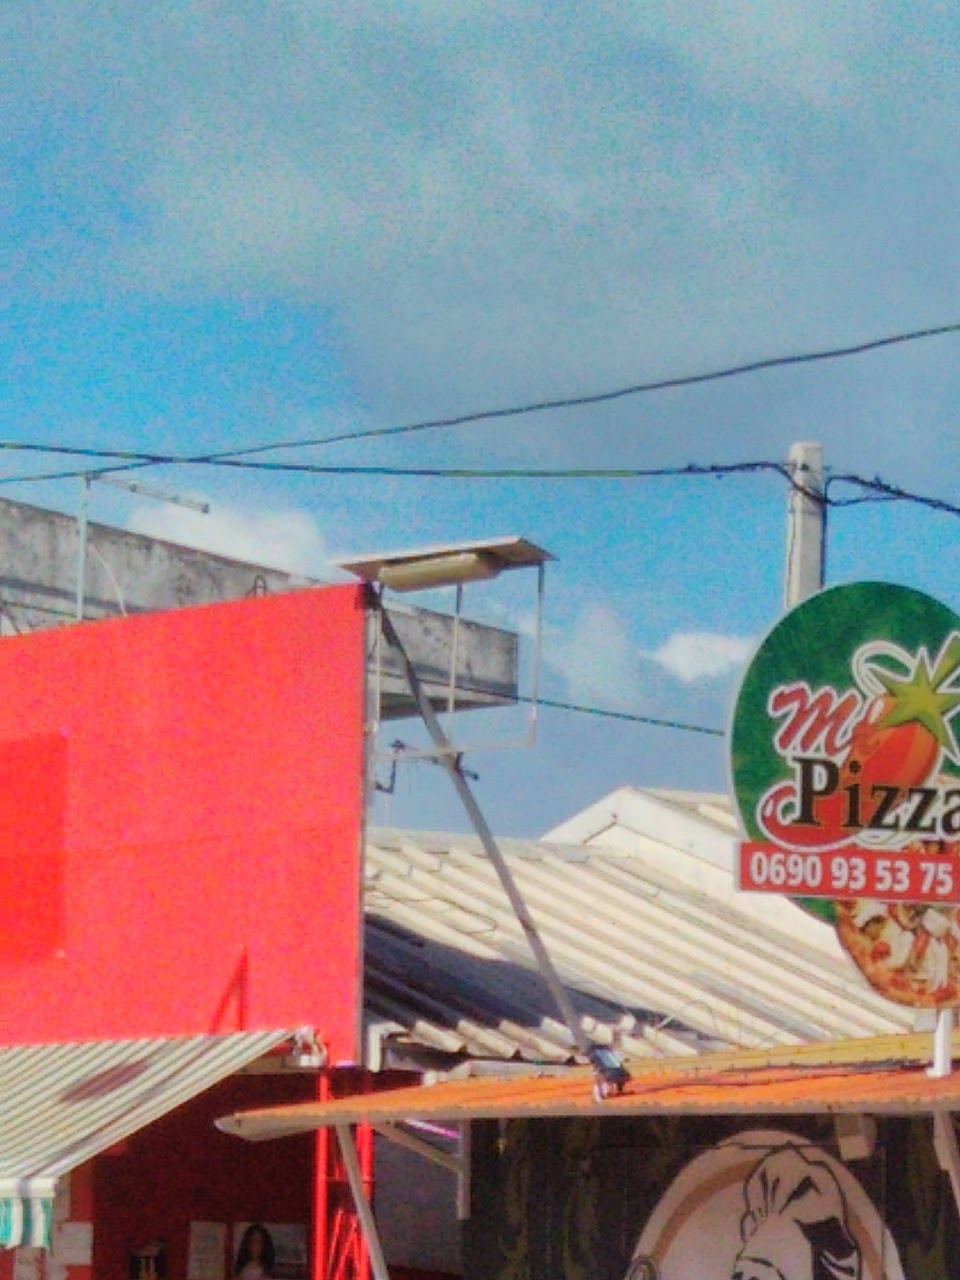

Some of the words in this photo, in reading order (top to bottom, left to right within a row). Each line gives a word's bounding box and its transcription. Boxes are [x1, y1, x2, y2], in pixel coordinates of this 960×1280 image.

[751, 851, 823, 887] 0690
[830, 856, 866, 890] 93
[874, 859, 910, 893] 53
[919, 862, 953, 895] 75
